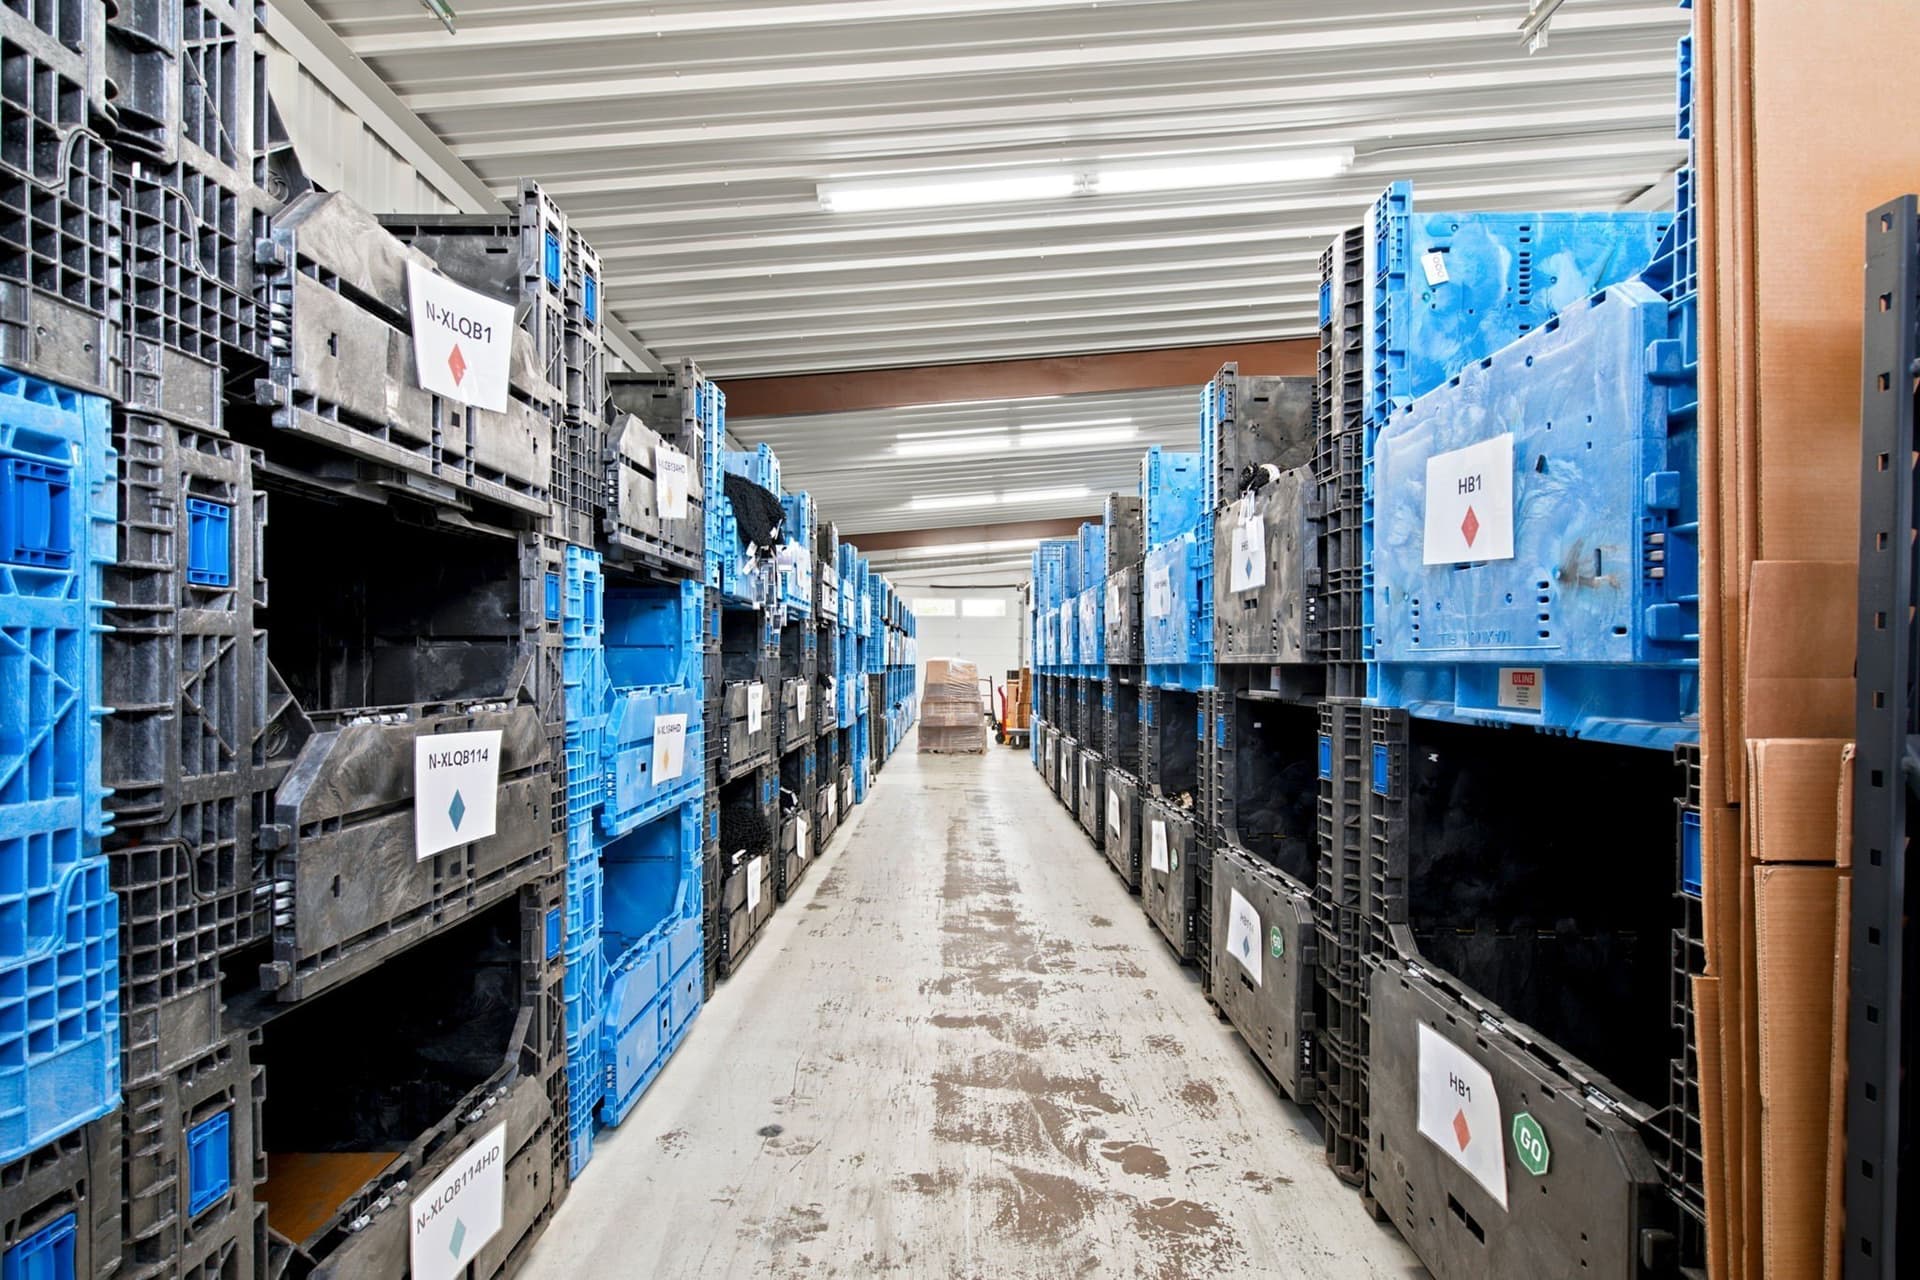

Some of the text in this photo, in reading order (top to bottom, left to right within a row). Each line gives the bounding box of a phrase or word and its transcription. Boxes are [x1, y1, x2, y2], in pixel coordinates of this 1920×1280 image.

[426, 300, 491, 344] N-XLQB1
[1458, 474, 1481, 495] HB1
[1513, 674, 1534, 684] ULINE
[429, 748, 488, 769] N-XLQB114
[1449, 1071, 1471, 1103] HB1
[1521, 1127, 1542, 1162] GO
[416, 1146, 500, 1235] N-XLQB114HD
